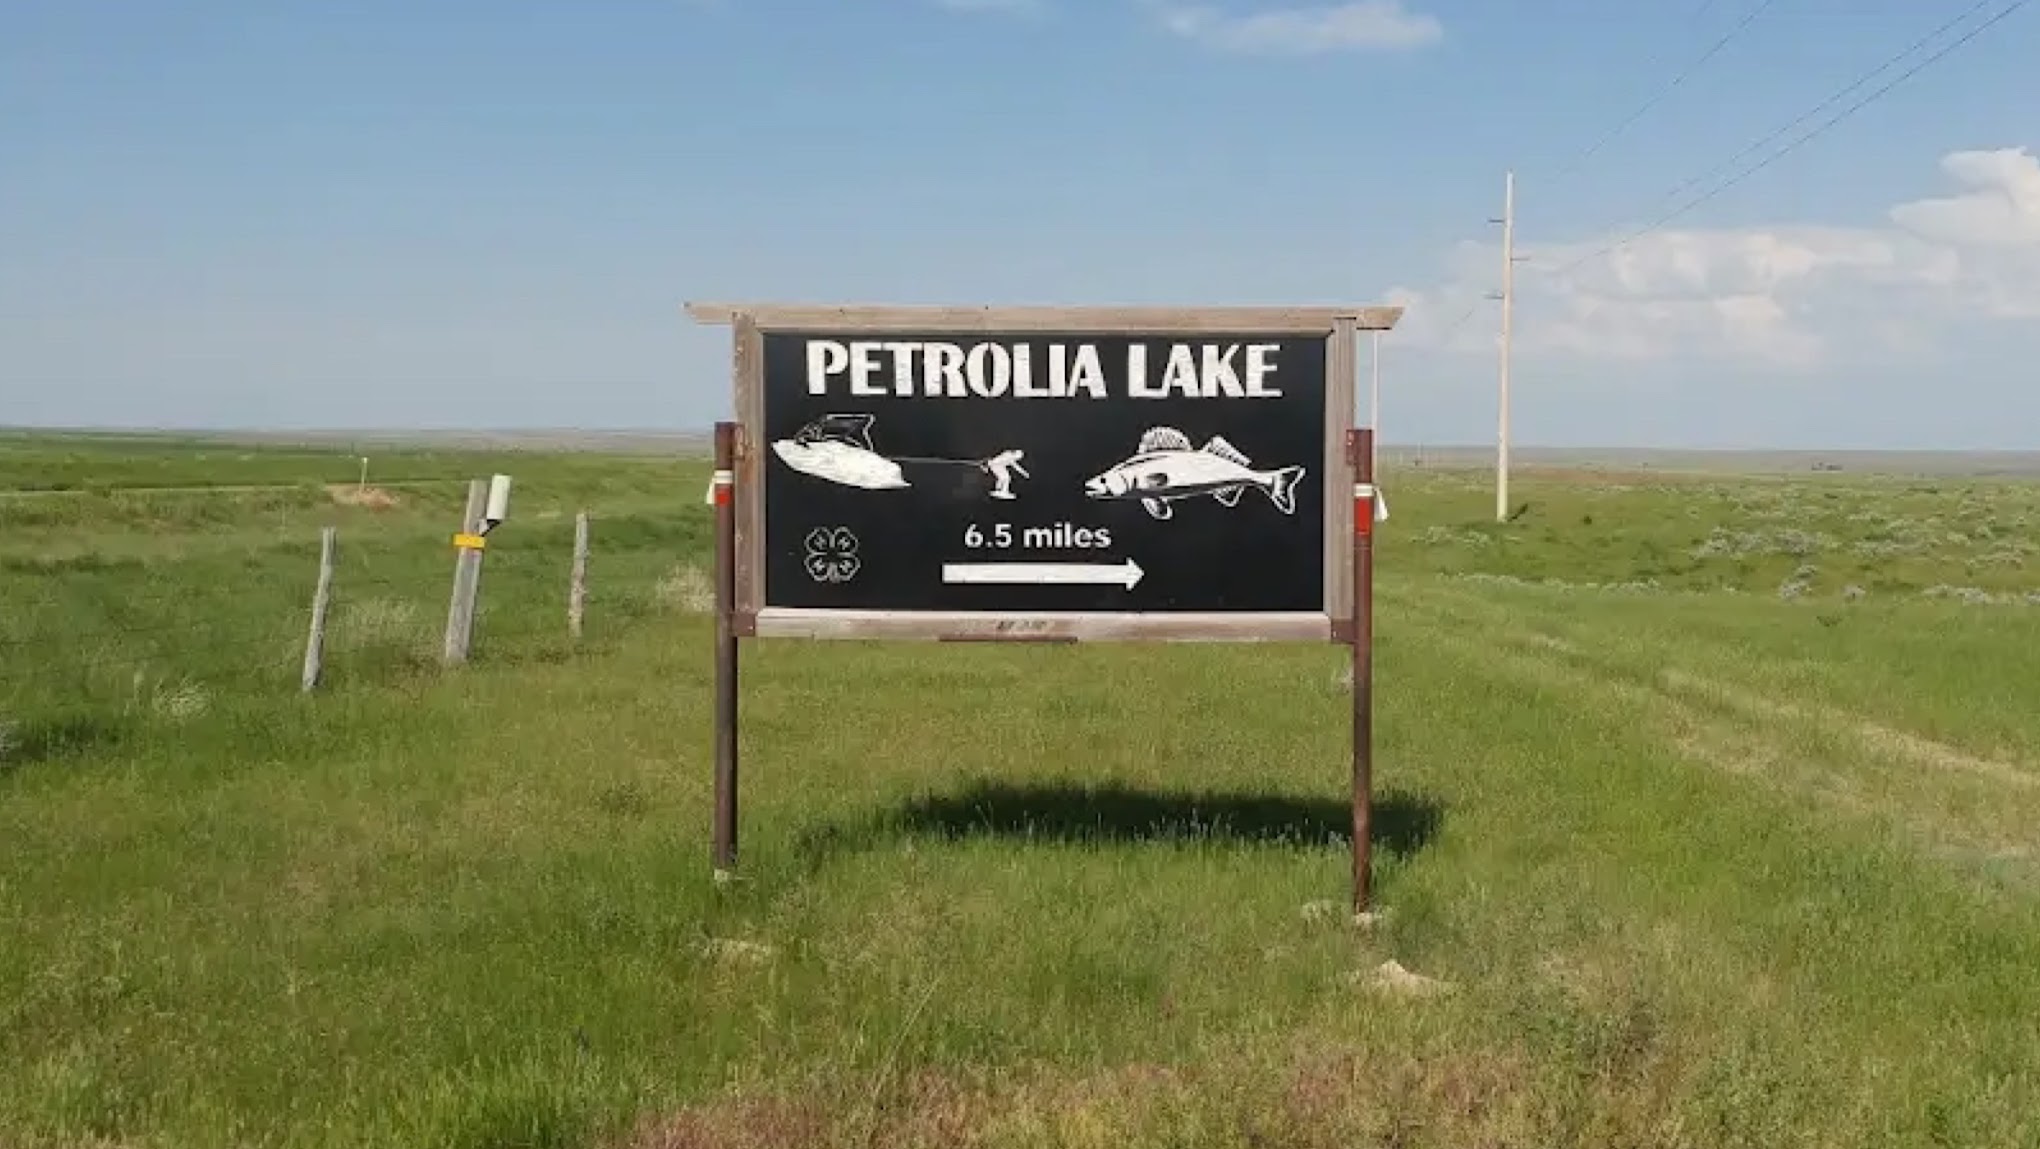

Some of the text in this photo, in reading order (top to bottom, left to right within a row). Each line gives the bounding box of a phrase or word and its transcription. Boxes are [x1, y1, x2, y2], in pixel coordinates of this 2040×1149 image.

[806, 340, 1282, 398] PETROLIA LAKE
[965, 523, 1111, 547] 6.5 miles
